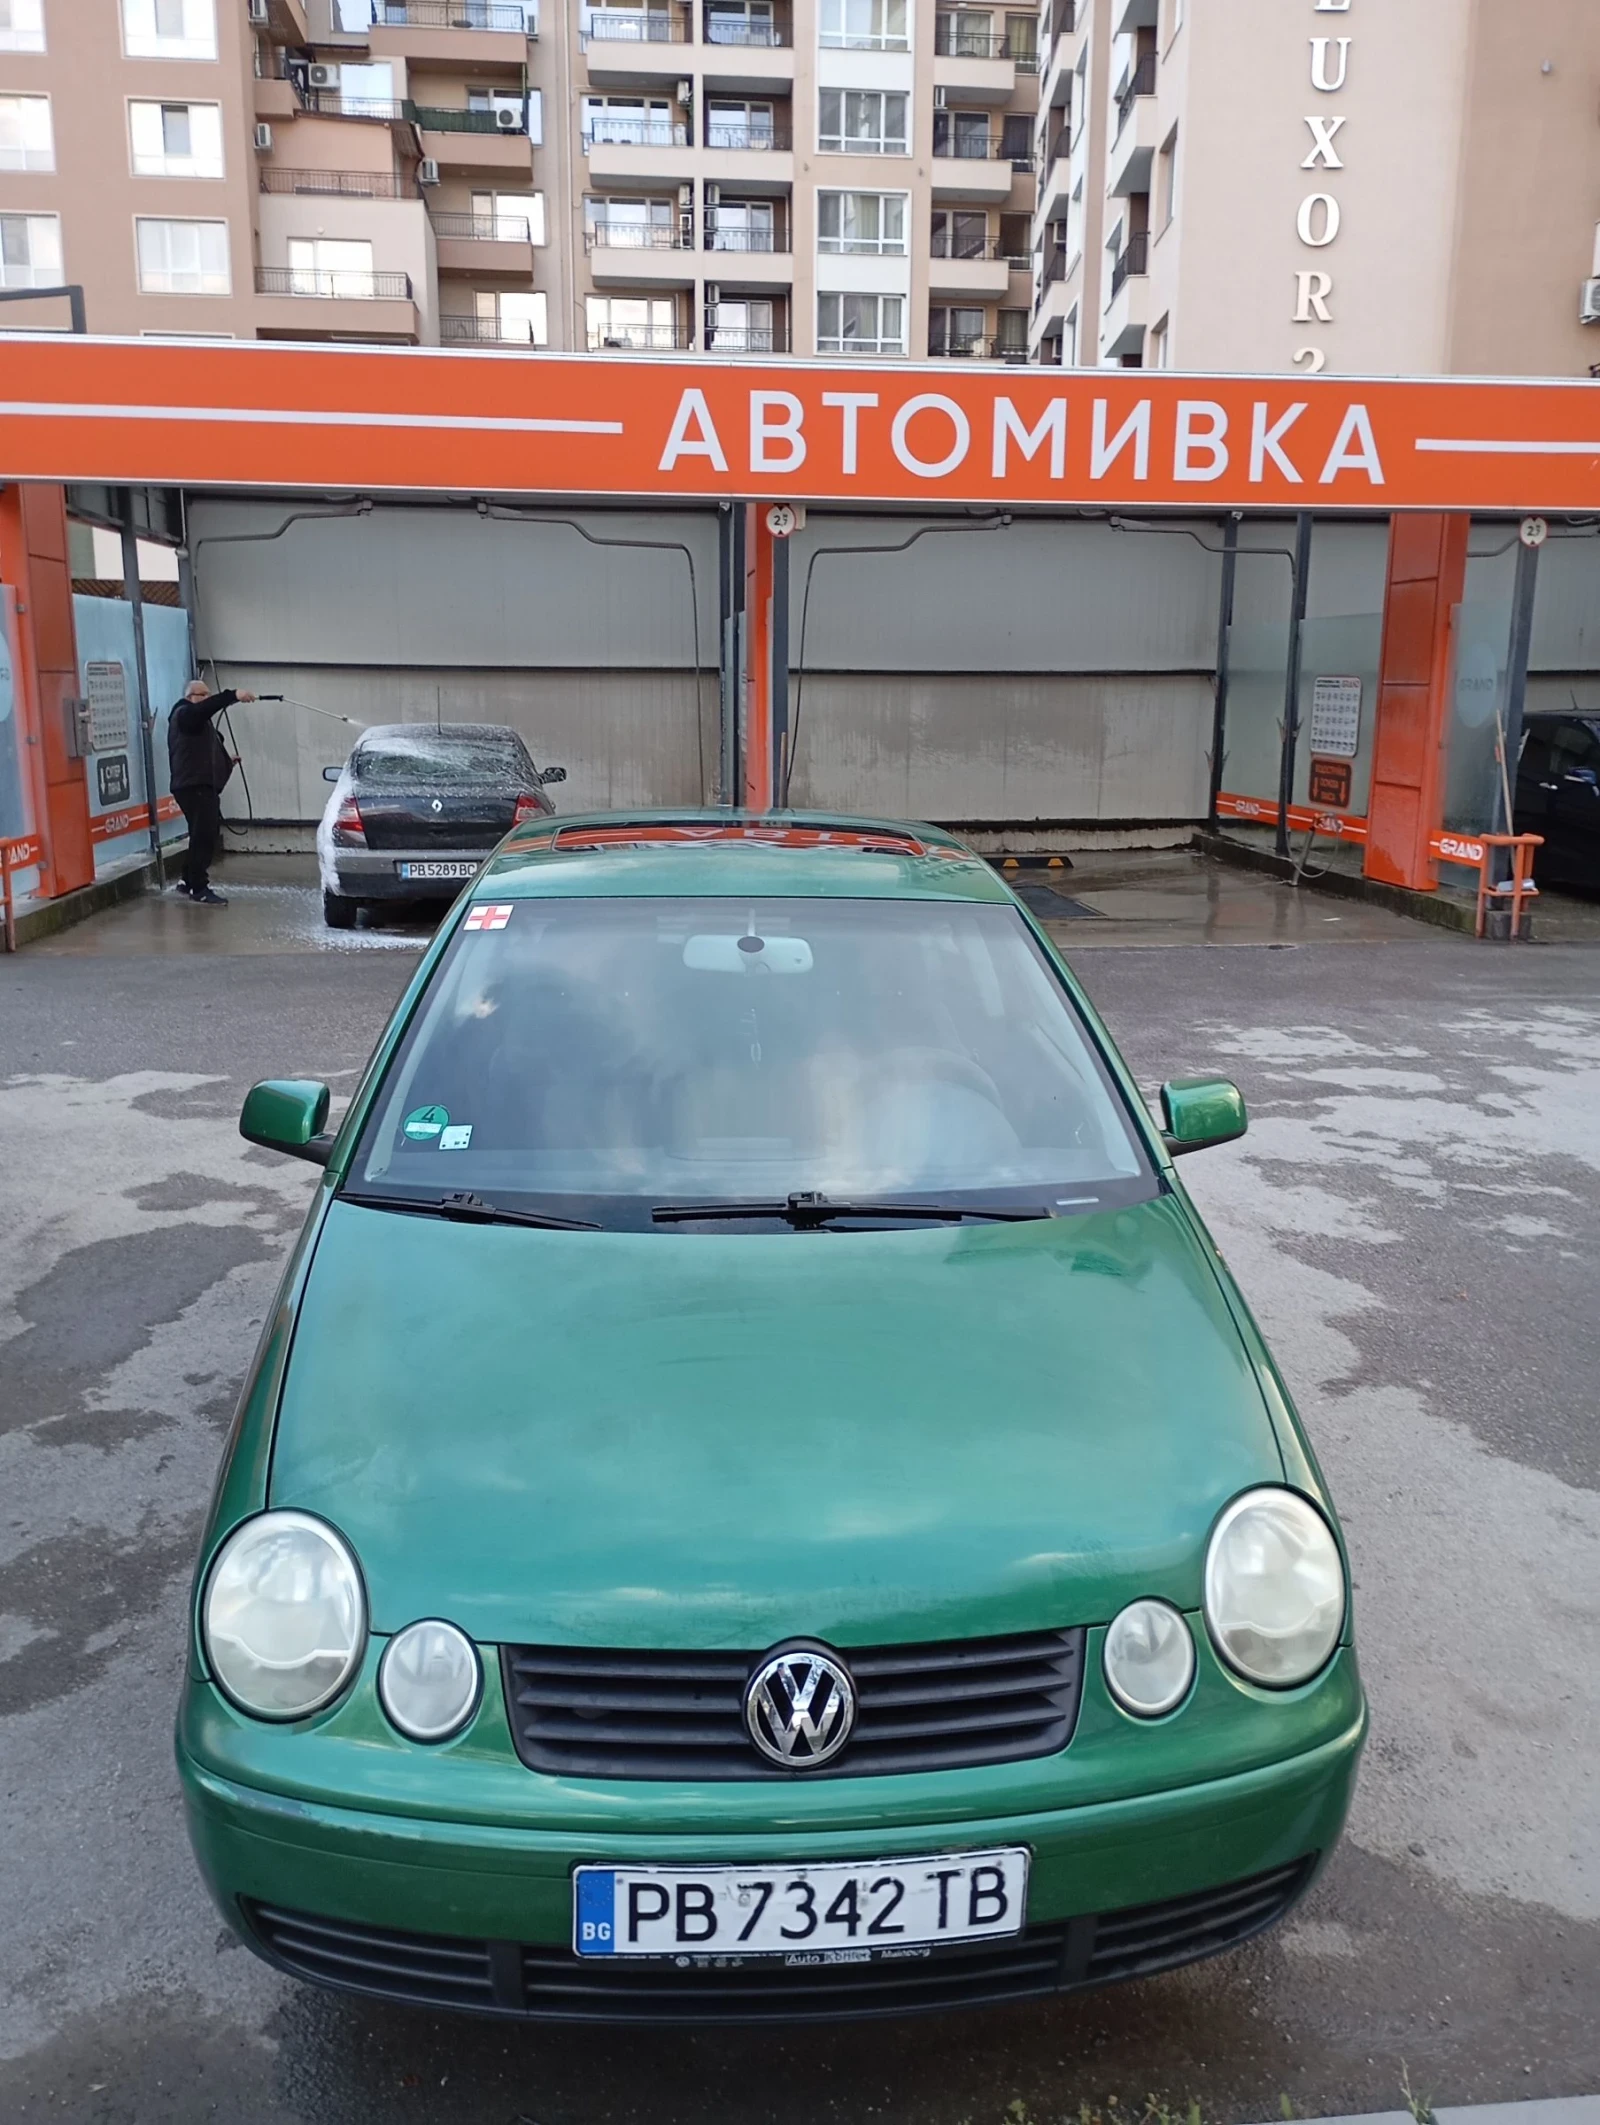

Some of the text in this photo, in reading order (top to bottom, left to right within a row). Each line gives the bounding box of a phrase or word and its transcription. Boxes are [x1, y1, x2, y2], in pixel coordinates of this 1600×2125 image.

[1292, 0, 1352, 322] UXOR
[657, 387, 1386, 486] АВТОМИВКА
[105, 813, 130, 833] GRAND
[1440, 838, 1484, 861] GRAND
[409, 864, 426, 876] PB
[427, 864, 457, 876] 5289
[421, 1107, 436, 1123] 4
[627, 1865, 1009, 1943] PB 7342 TB
[582, 1921, 612, 1942] BG
[788, 1954, 820, 1964] Auto
